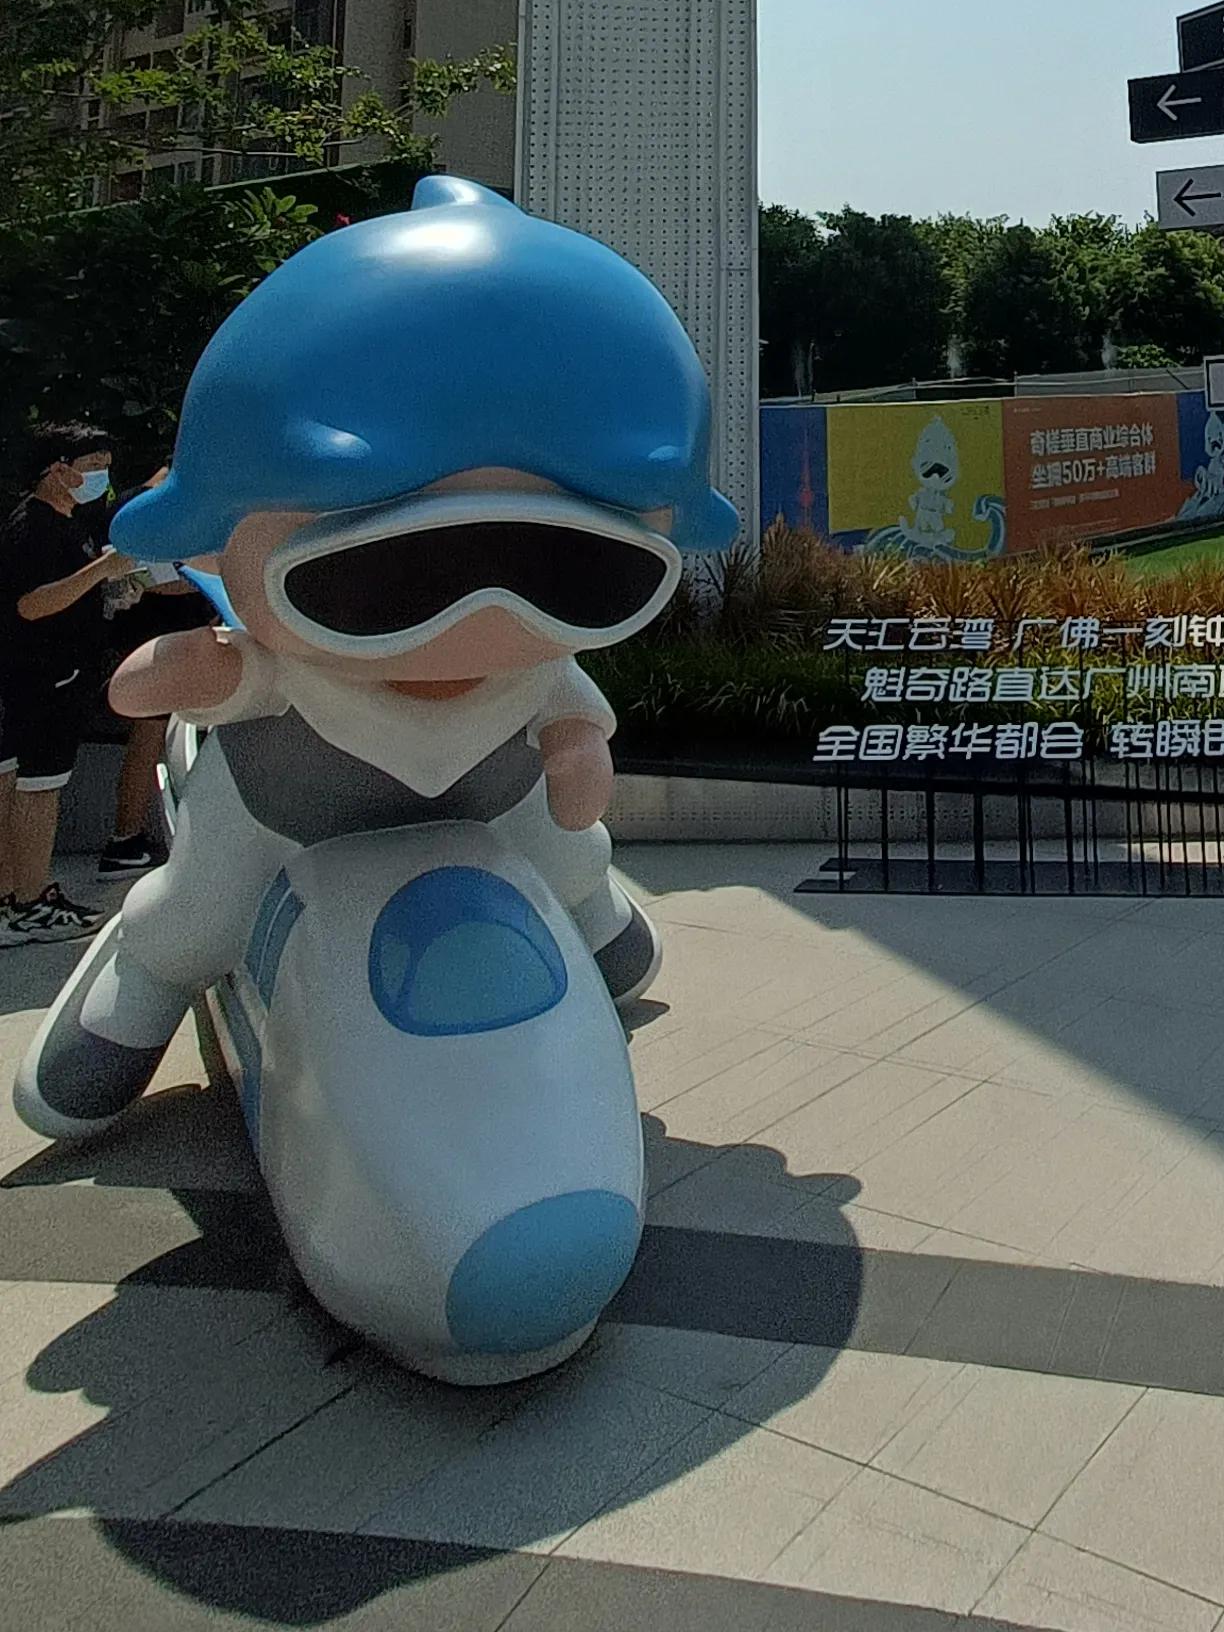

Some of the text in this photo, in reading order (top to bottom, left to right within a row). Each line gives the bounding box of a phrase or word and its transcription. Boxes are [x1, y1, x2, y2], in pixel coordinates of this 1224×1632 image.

[823, 618, 994, 651] 天汇云湾
[813, 721, 1084, 761] 全国繁华都会
